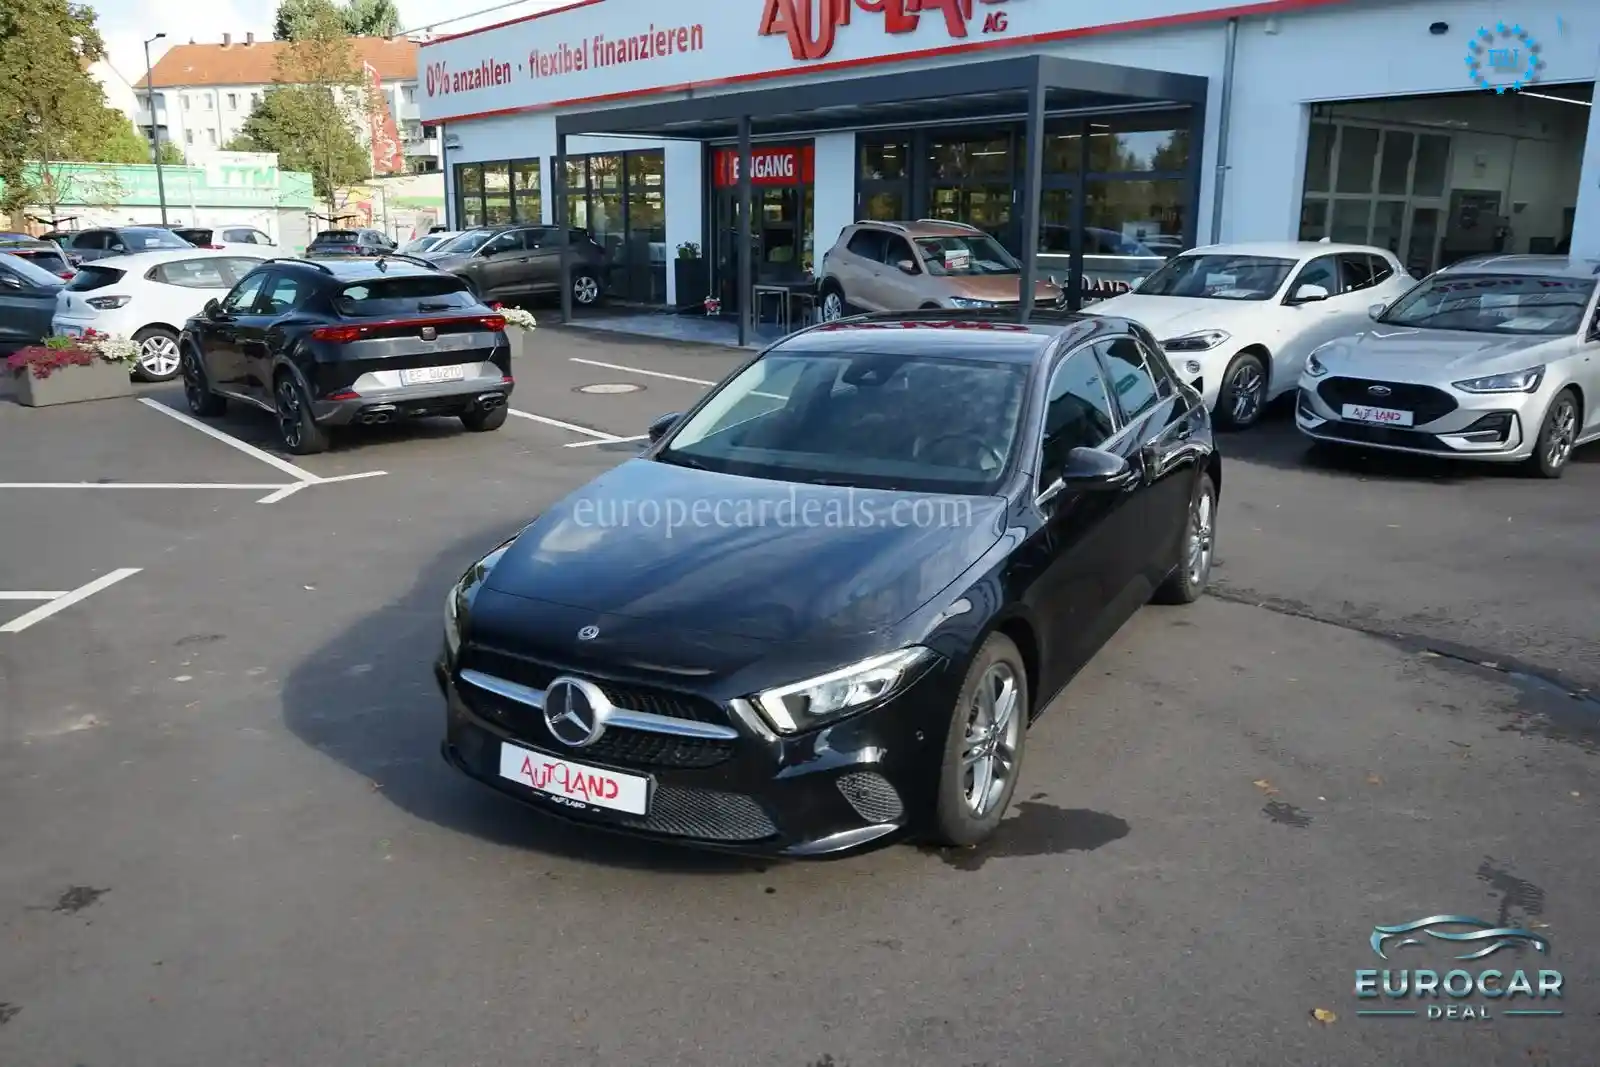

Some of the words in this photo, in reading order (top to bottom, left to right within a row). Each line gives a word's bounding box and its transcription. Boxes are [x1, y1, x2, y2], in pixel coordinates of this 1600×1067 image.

[758, 0, 1030, 60] AULA
[981, 11, 1009, 33] AG
[426, 61, 451, 97] 0%
[453, 58, 511, 93] anzahlen
[529, 38, 589, 79] flexibel
[592, 23, 704, 69] finanzieren
[732, 153, 794, 179] EGANG
[520, 755, 619, 801] AUTOLAND
